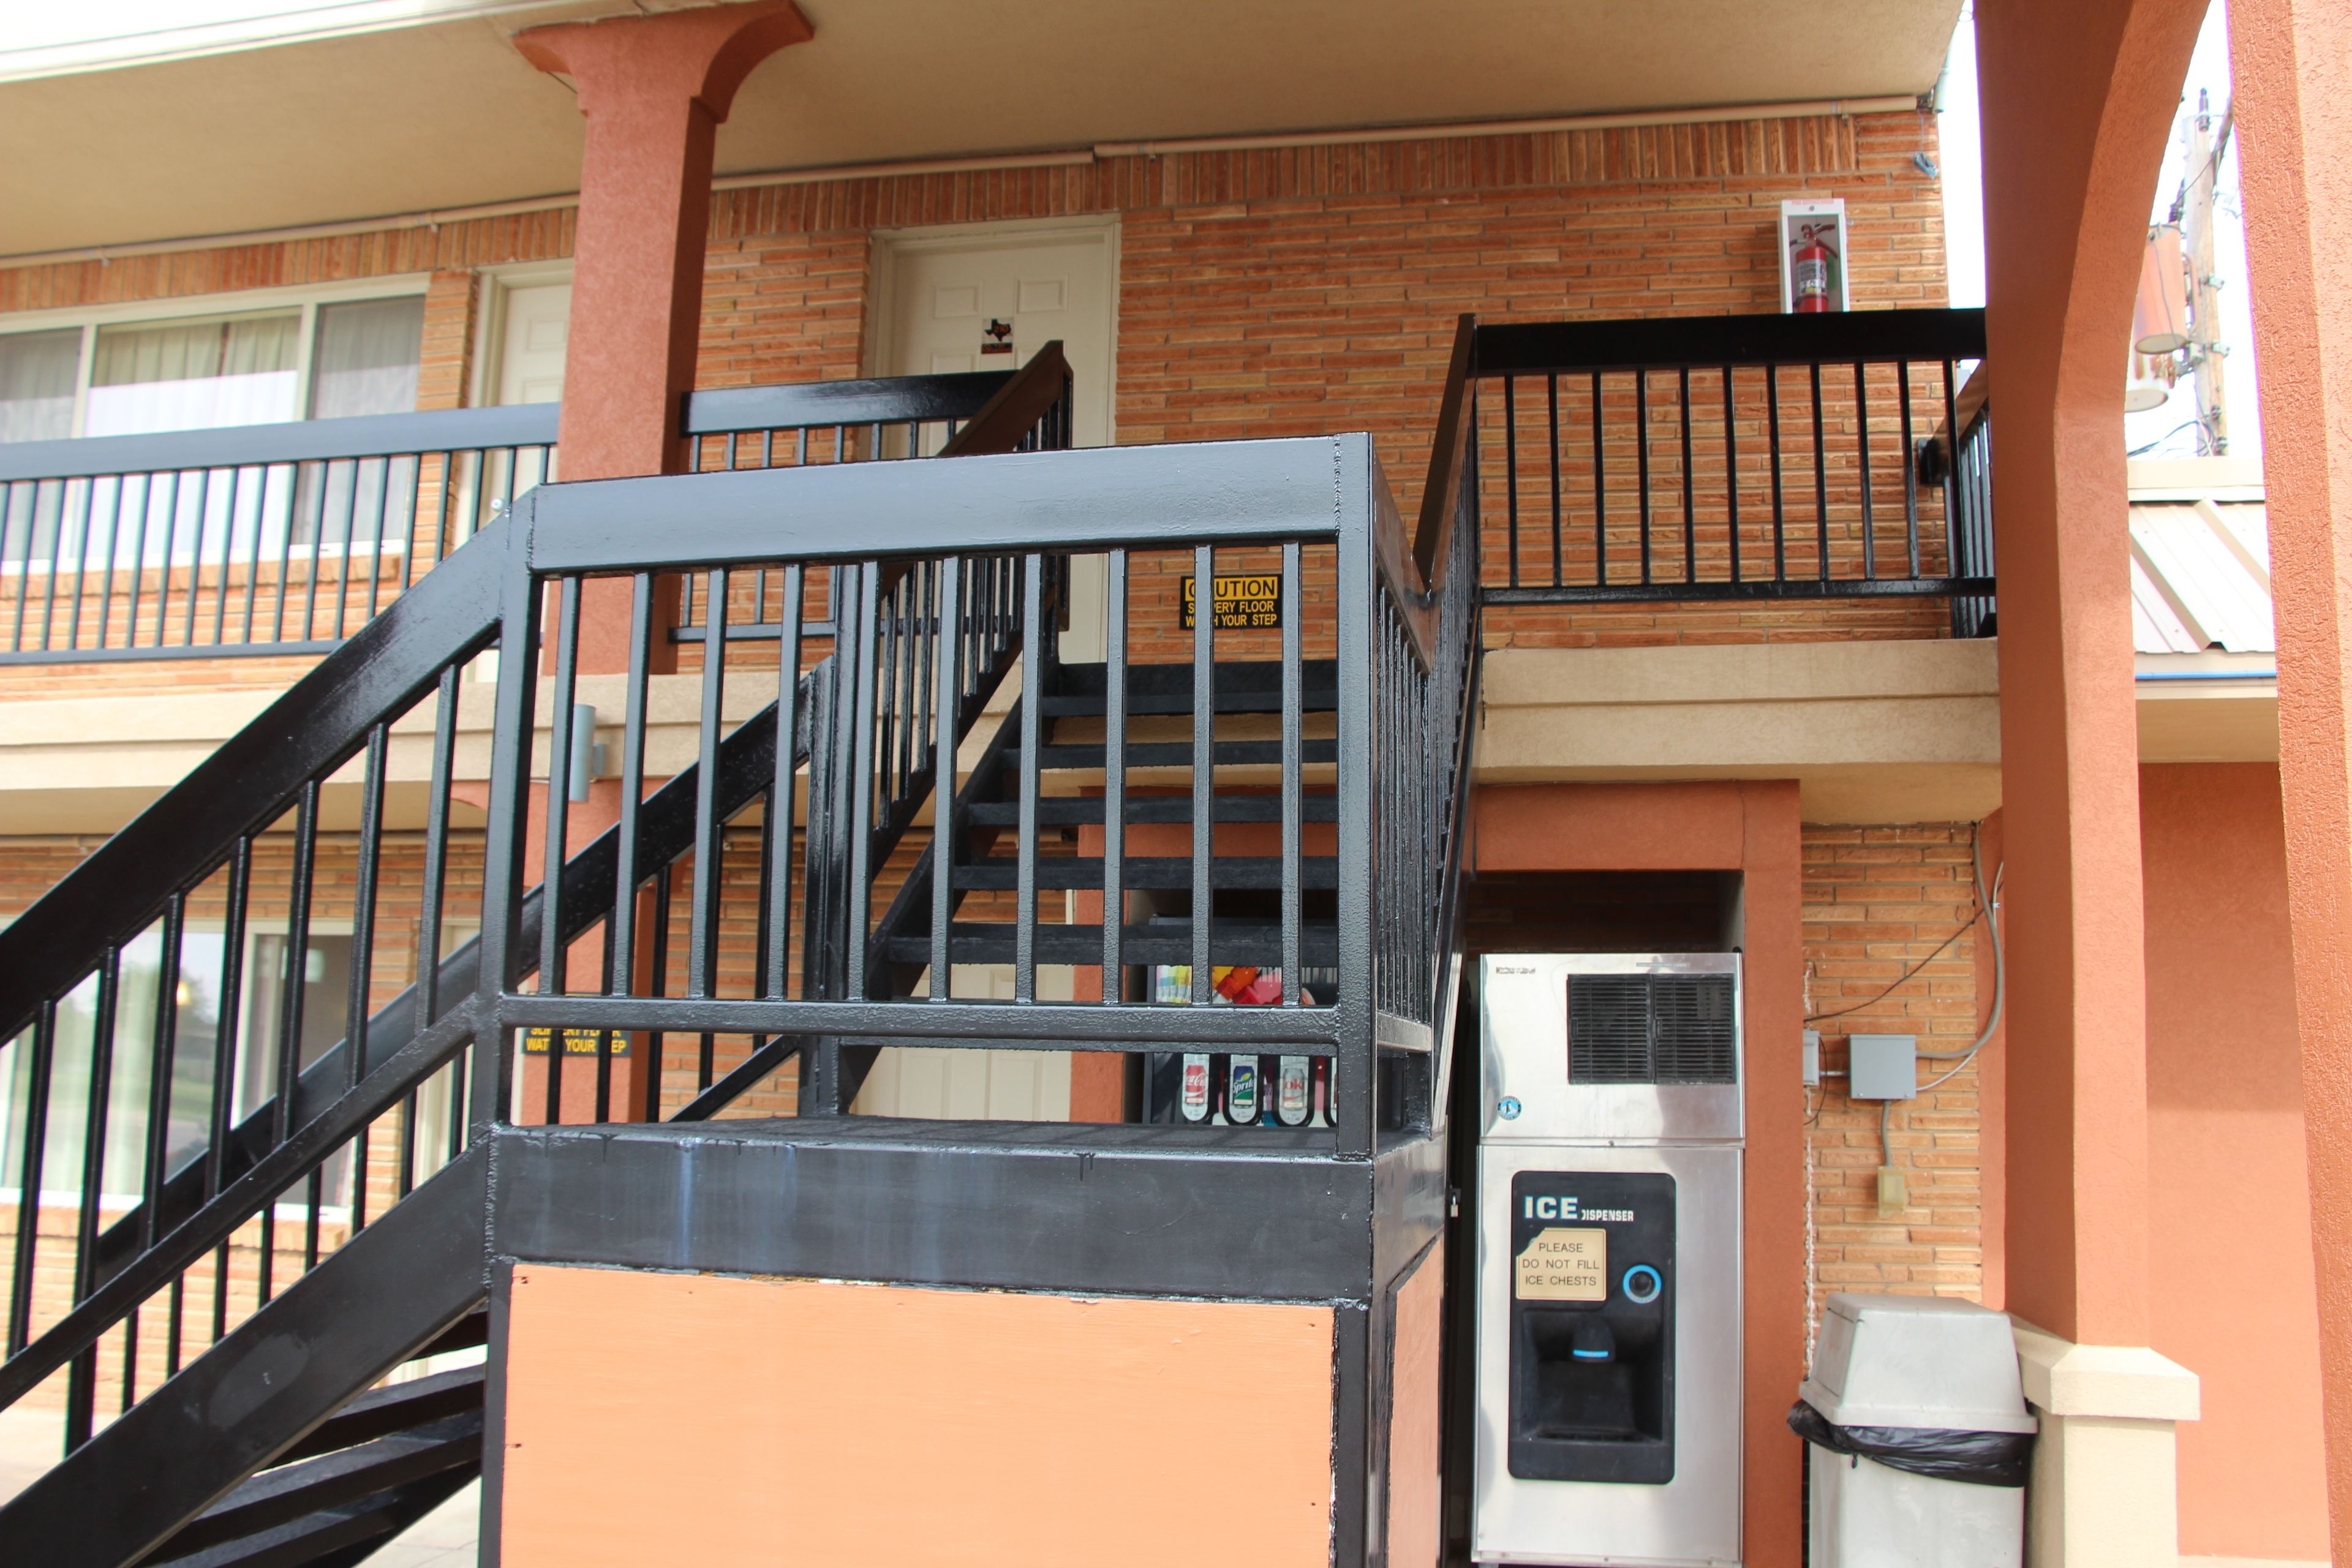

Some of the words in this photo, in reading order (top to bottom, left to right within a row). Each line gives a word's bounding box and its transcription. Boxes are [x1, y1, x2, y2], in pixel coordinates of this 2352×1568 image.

[1189, 579, 1275, 598] UTION
[1188, 601, 1235, 614] SERY
[1240, 601, 1274, 612] FLOOR
[1221, 614, 1247, 626] YOUR
[1253, 613, 1276, 625] STEP
[526, 1038, 550, 1051] WAT
[565, 1038, 597, 1052] YOUR
[611, 1039, 627, 1053] EP
[1525, 1196, 1578, 1219] ICE
[1539, 1243, 1583, 1253] PLEASE
[1523, 1259, 1539, 1268] DO
[1546, 1259, 1570, 1269] NOT
[1577, 1259, 1600, 1270] FILL
[1526, 1275, 1544, 1285] ICE
[1550, 1276, 1596, 1286] CHESTS
